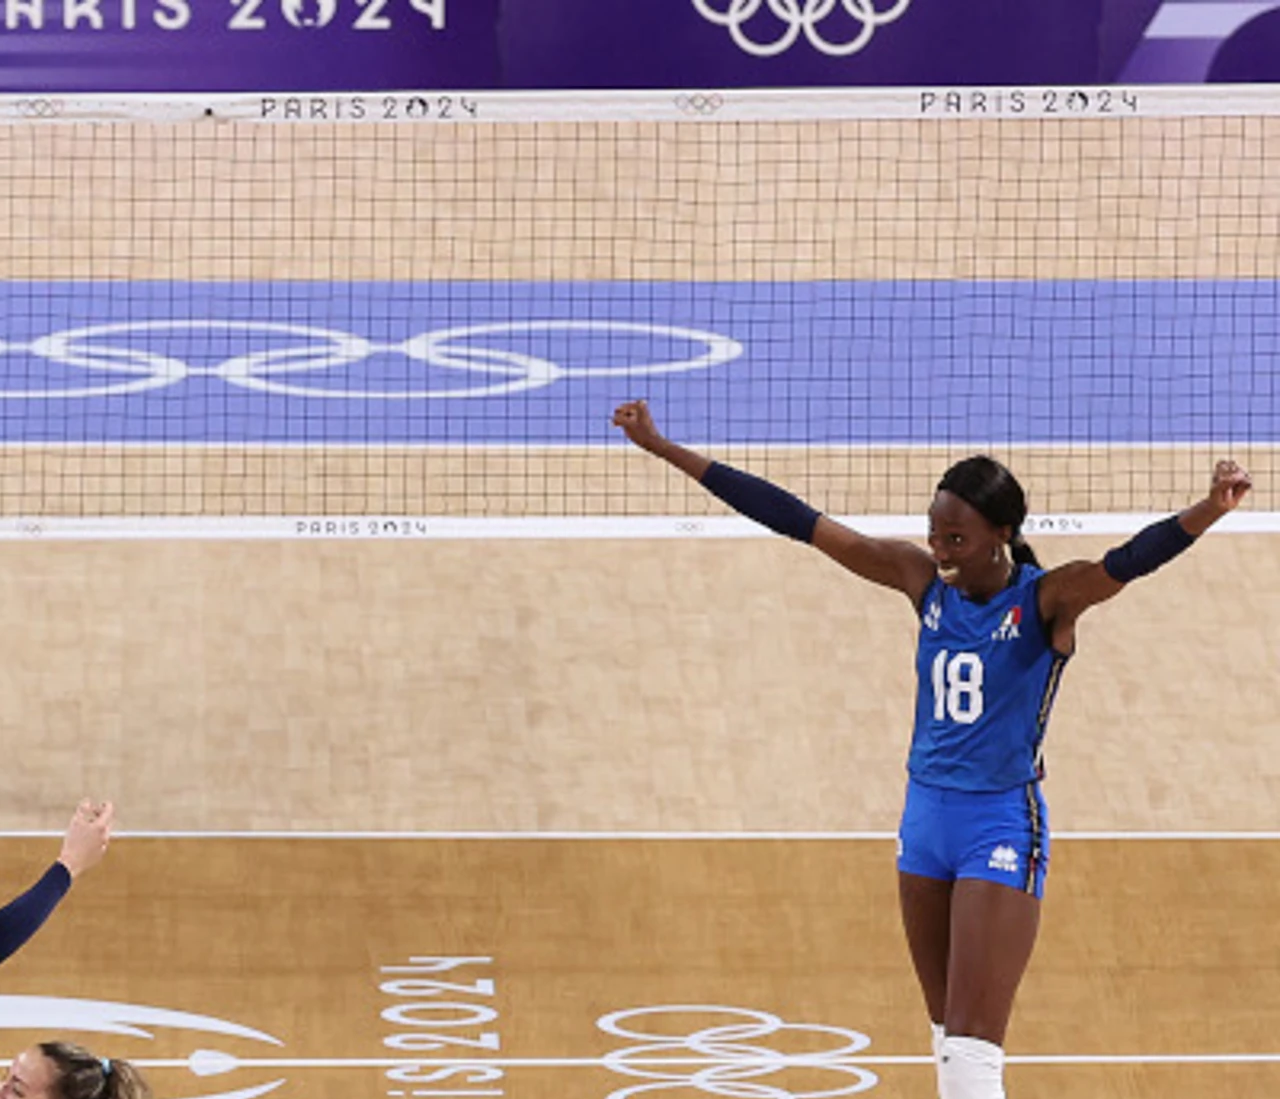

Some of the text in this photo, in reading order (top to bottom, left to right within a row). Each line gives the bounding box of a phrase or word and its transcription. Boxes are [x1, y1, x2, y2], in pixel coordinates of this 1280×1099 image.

[228, 0, 446, 30] 2024
[261, 96, 477, 119] PARIS 2024
[920, 90, 1137, 113] PARIS 2024
[296, 520, 360, 535] PARIS
[932, 649, 984, 724] 18
[378, 956, 501, 1051] 2024
